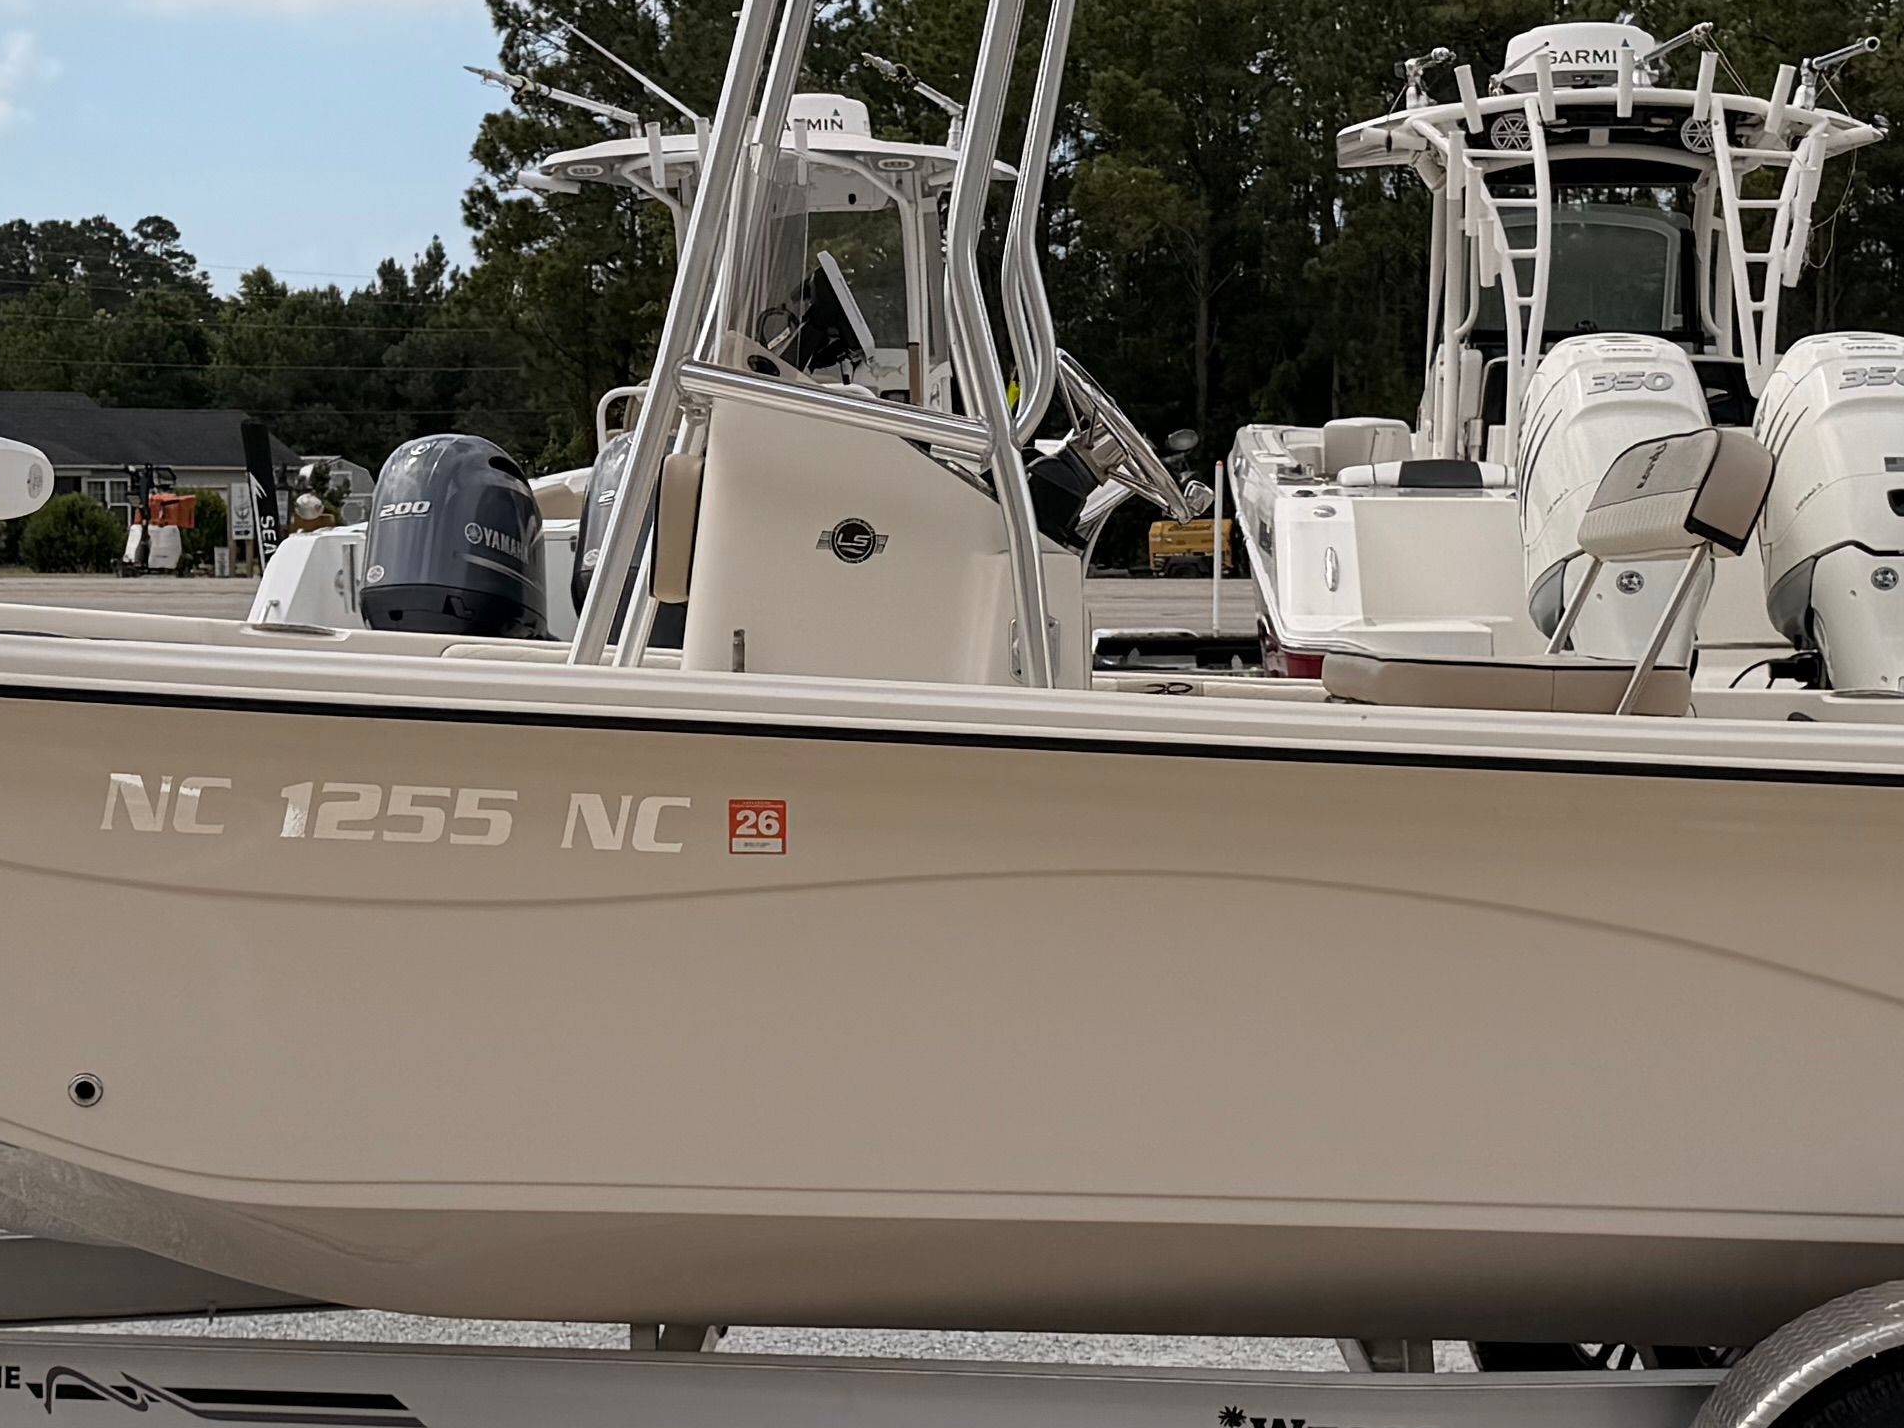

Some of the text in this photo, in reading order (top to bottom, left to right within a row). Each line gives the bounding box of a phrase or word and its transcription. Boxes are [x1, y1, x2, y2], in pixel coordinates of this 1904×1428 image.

[1549, 49, 1617, 64] GARMI
[1586, 372, 1674, 395] 350
[380, 500, 431, 518] 200
[837, 533, 872, 547] LS
[100, 773, 692, 853] NC 1255 NC
[736, 809, 780, 836] 26
